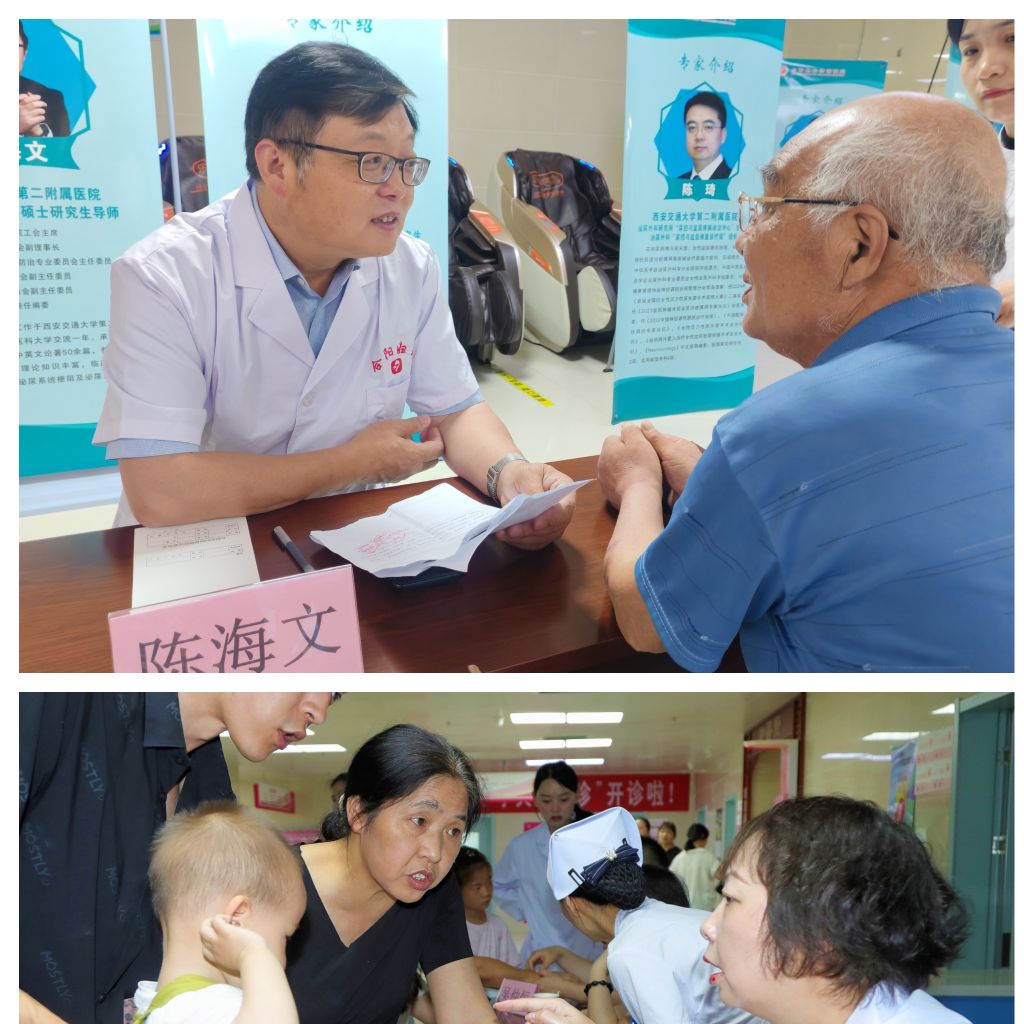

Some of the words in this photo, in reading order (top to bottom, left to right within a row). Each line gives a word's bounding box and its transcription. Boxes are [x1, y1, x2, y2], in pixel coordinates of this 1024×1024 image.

[679, 52, 735, 73] 专家介绍
[19, 140, 49, 163] 文
[19, 186, 101, 201] 第二附属医院
[20, 204, 119, 219] 硕士研究生导师
[19, 286, 73, 296] 会副主任委员
[19, 320, 111, 332] 作于西安交通大学第
[138, 602, 342, 673] 陈海文
